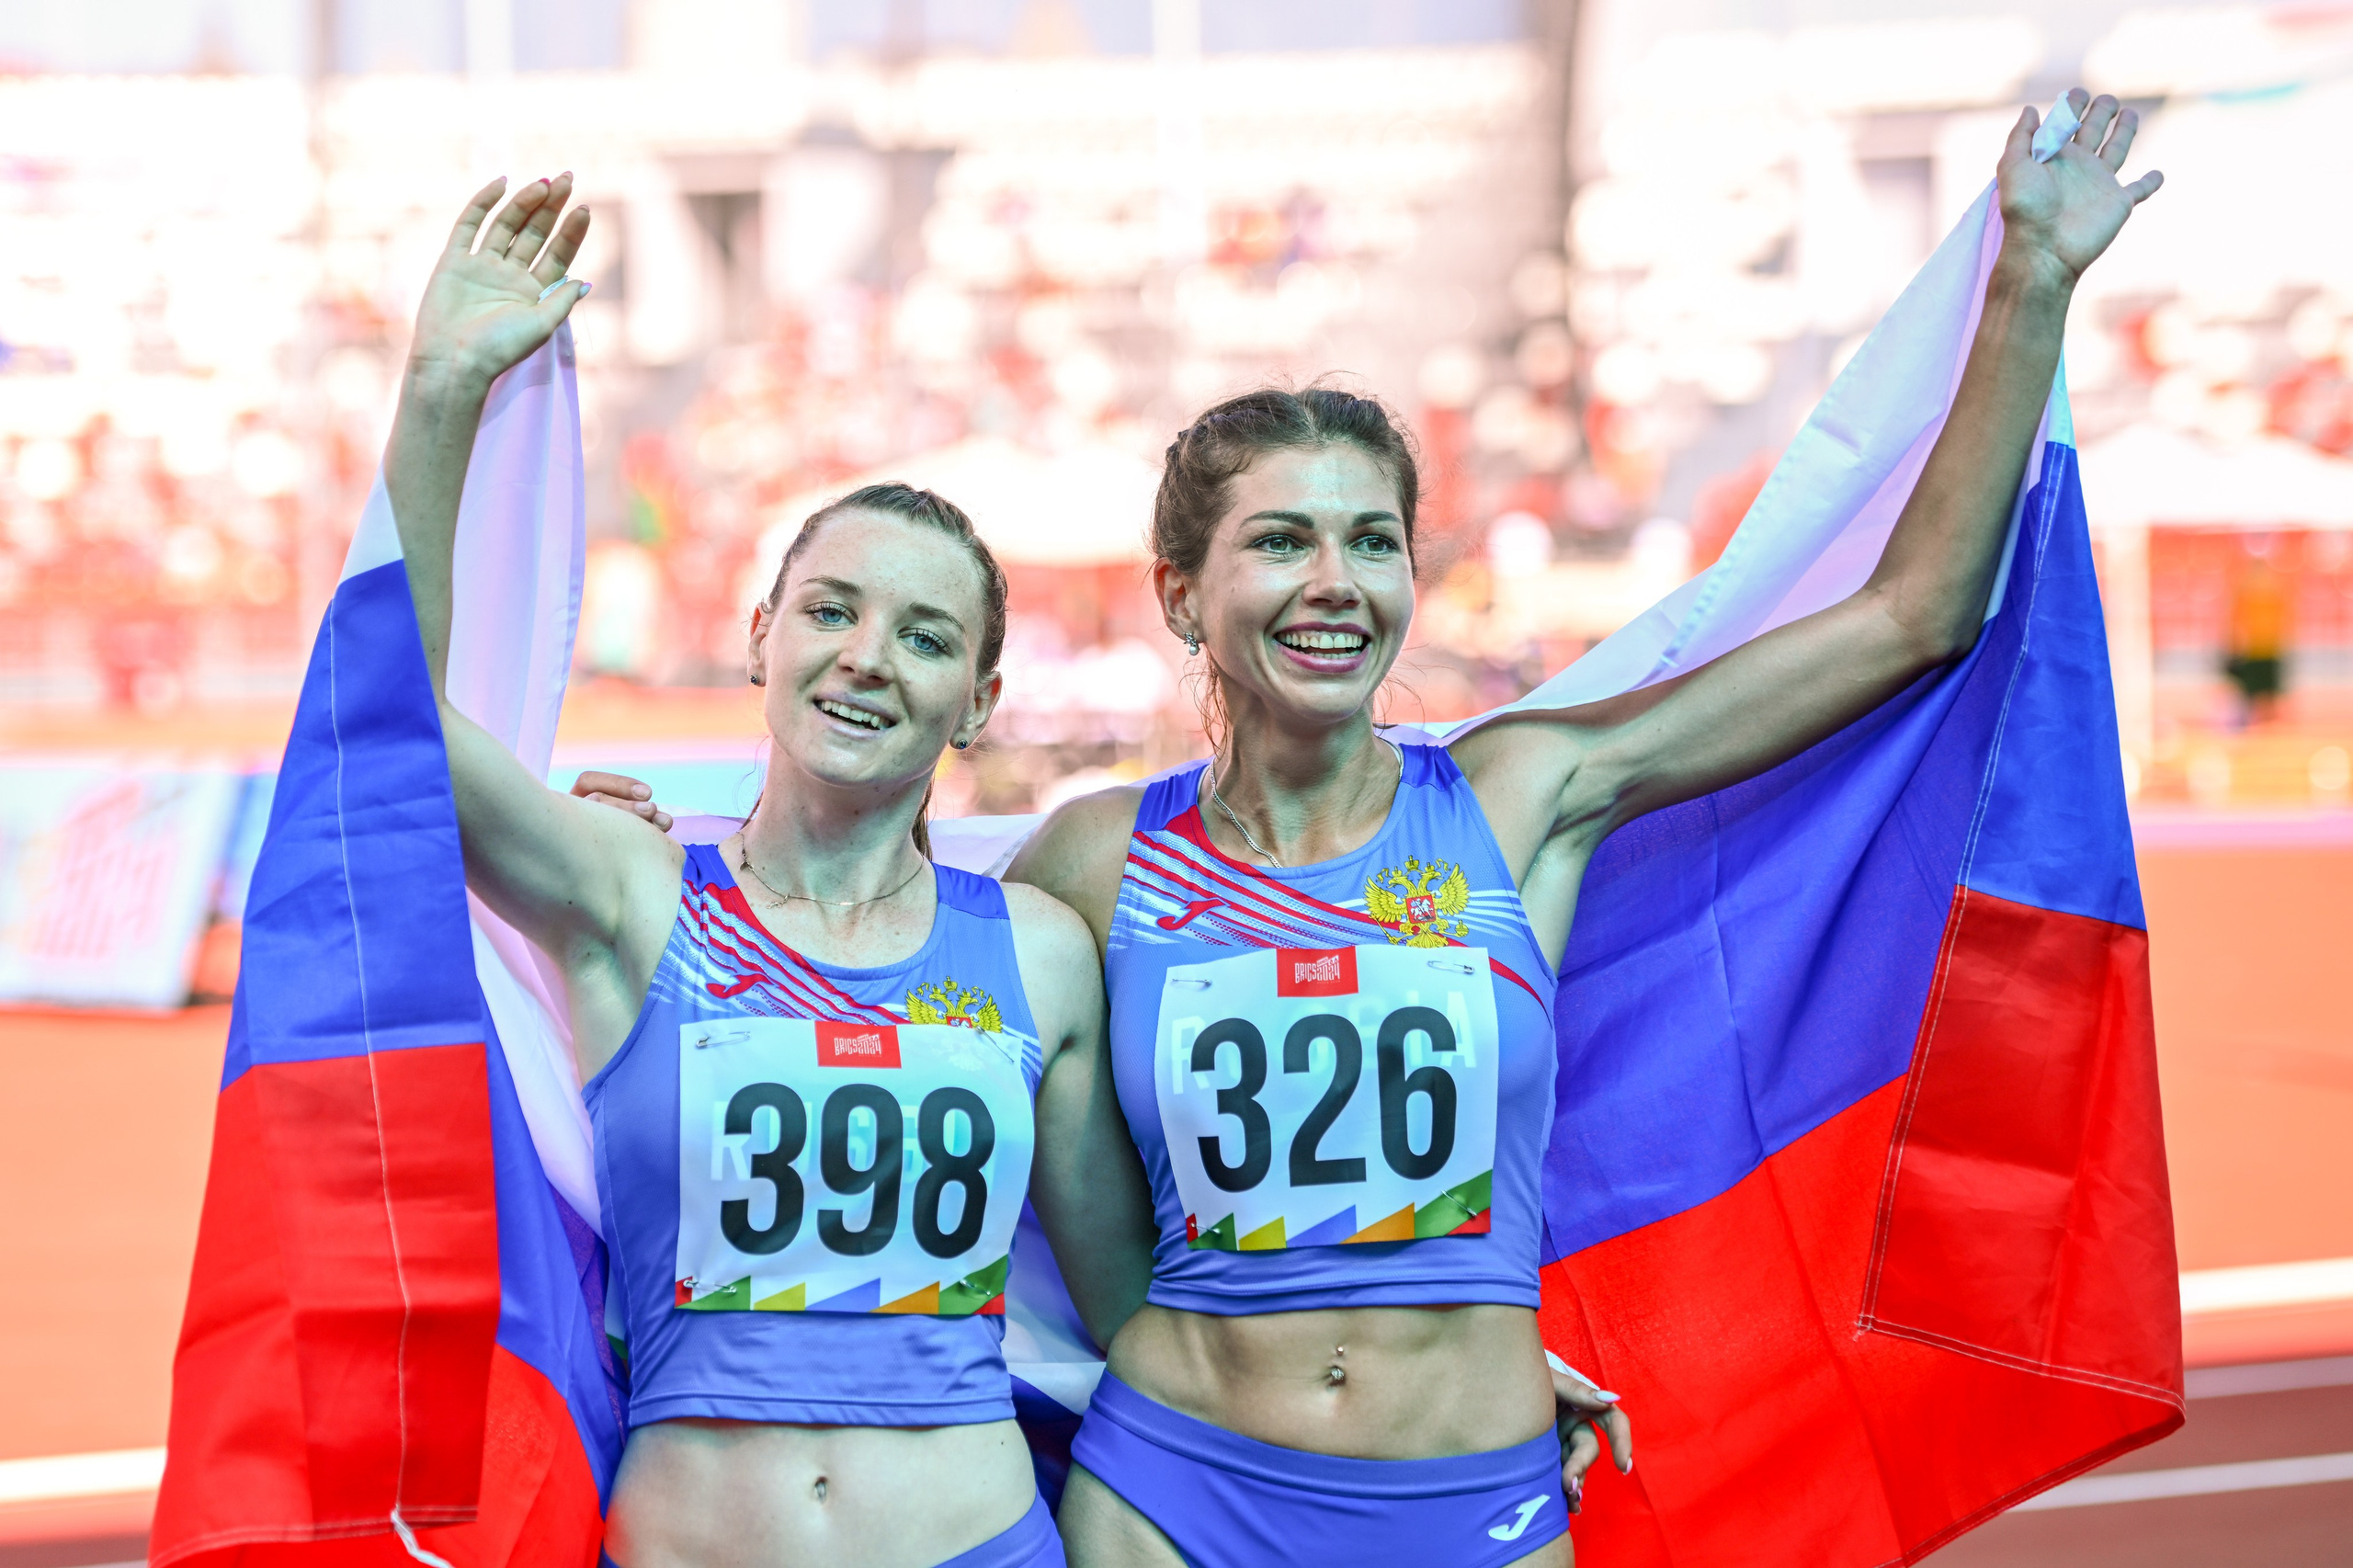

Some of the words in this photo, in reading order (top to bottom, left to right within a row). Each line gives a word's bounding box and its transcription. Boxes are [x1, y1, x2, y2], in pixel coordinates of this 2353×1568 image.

[1294, 962, 1316, 984] BRICS
[1316, 961, 1340, 982] 2024
[834, 1038, 858, 1056] BRICS
[858, 1039, 882, 1055] 2024
[1190, 1006, 1458, 1193] 326
[720, 1082, 995, 1259] 398
